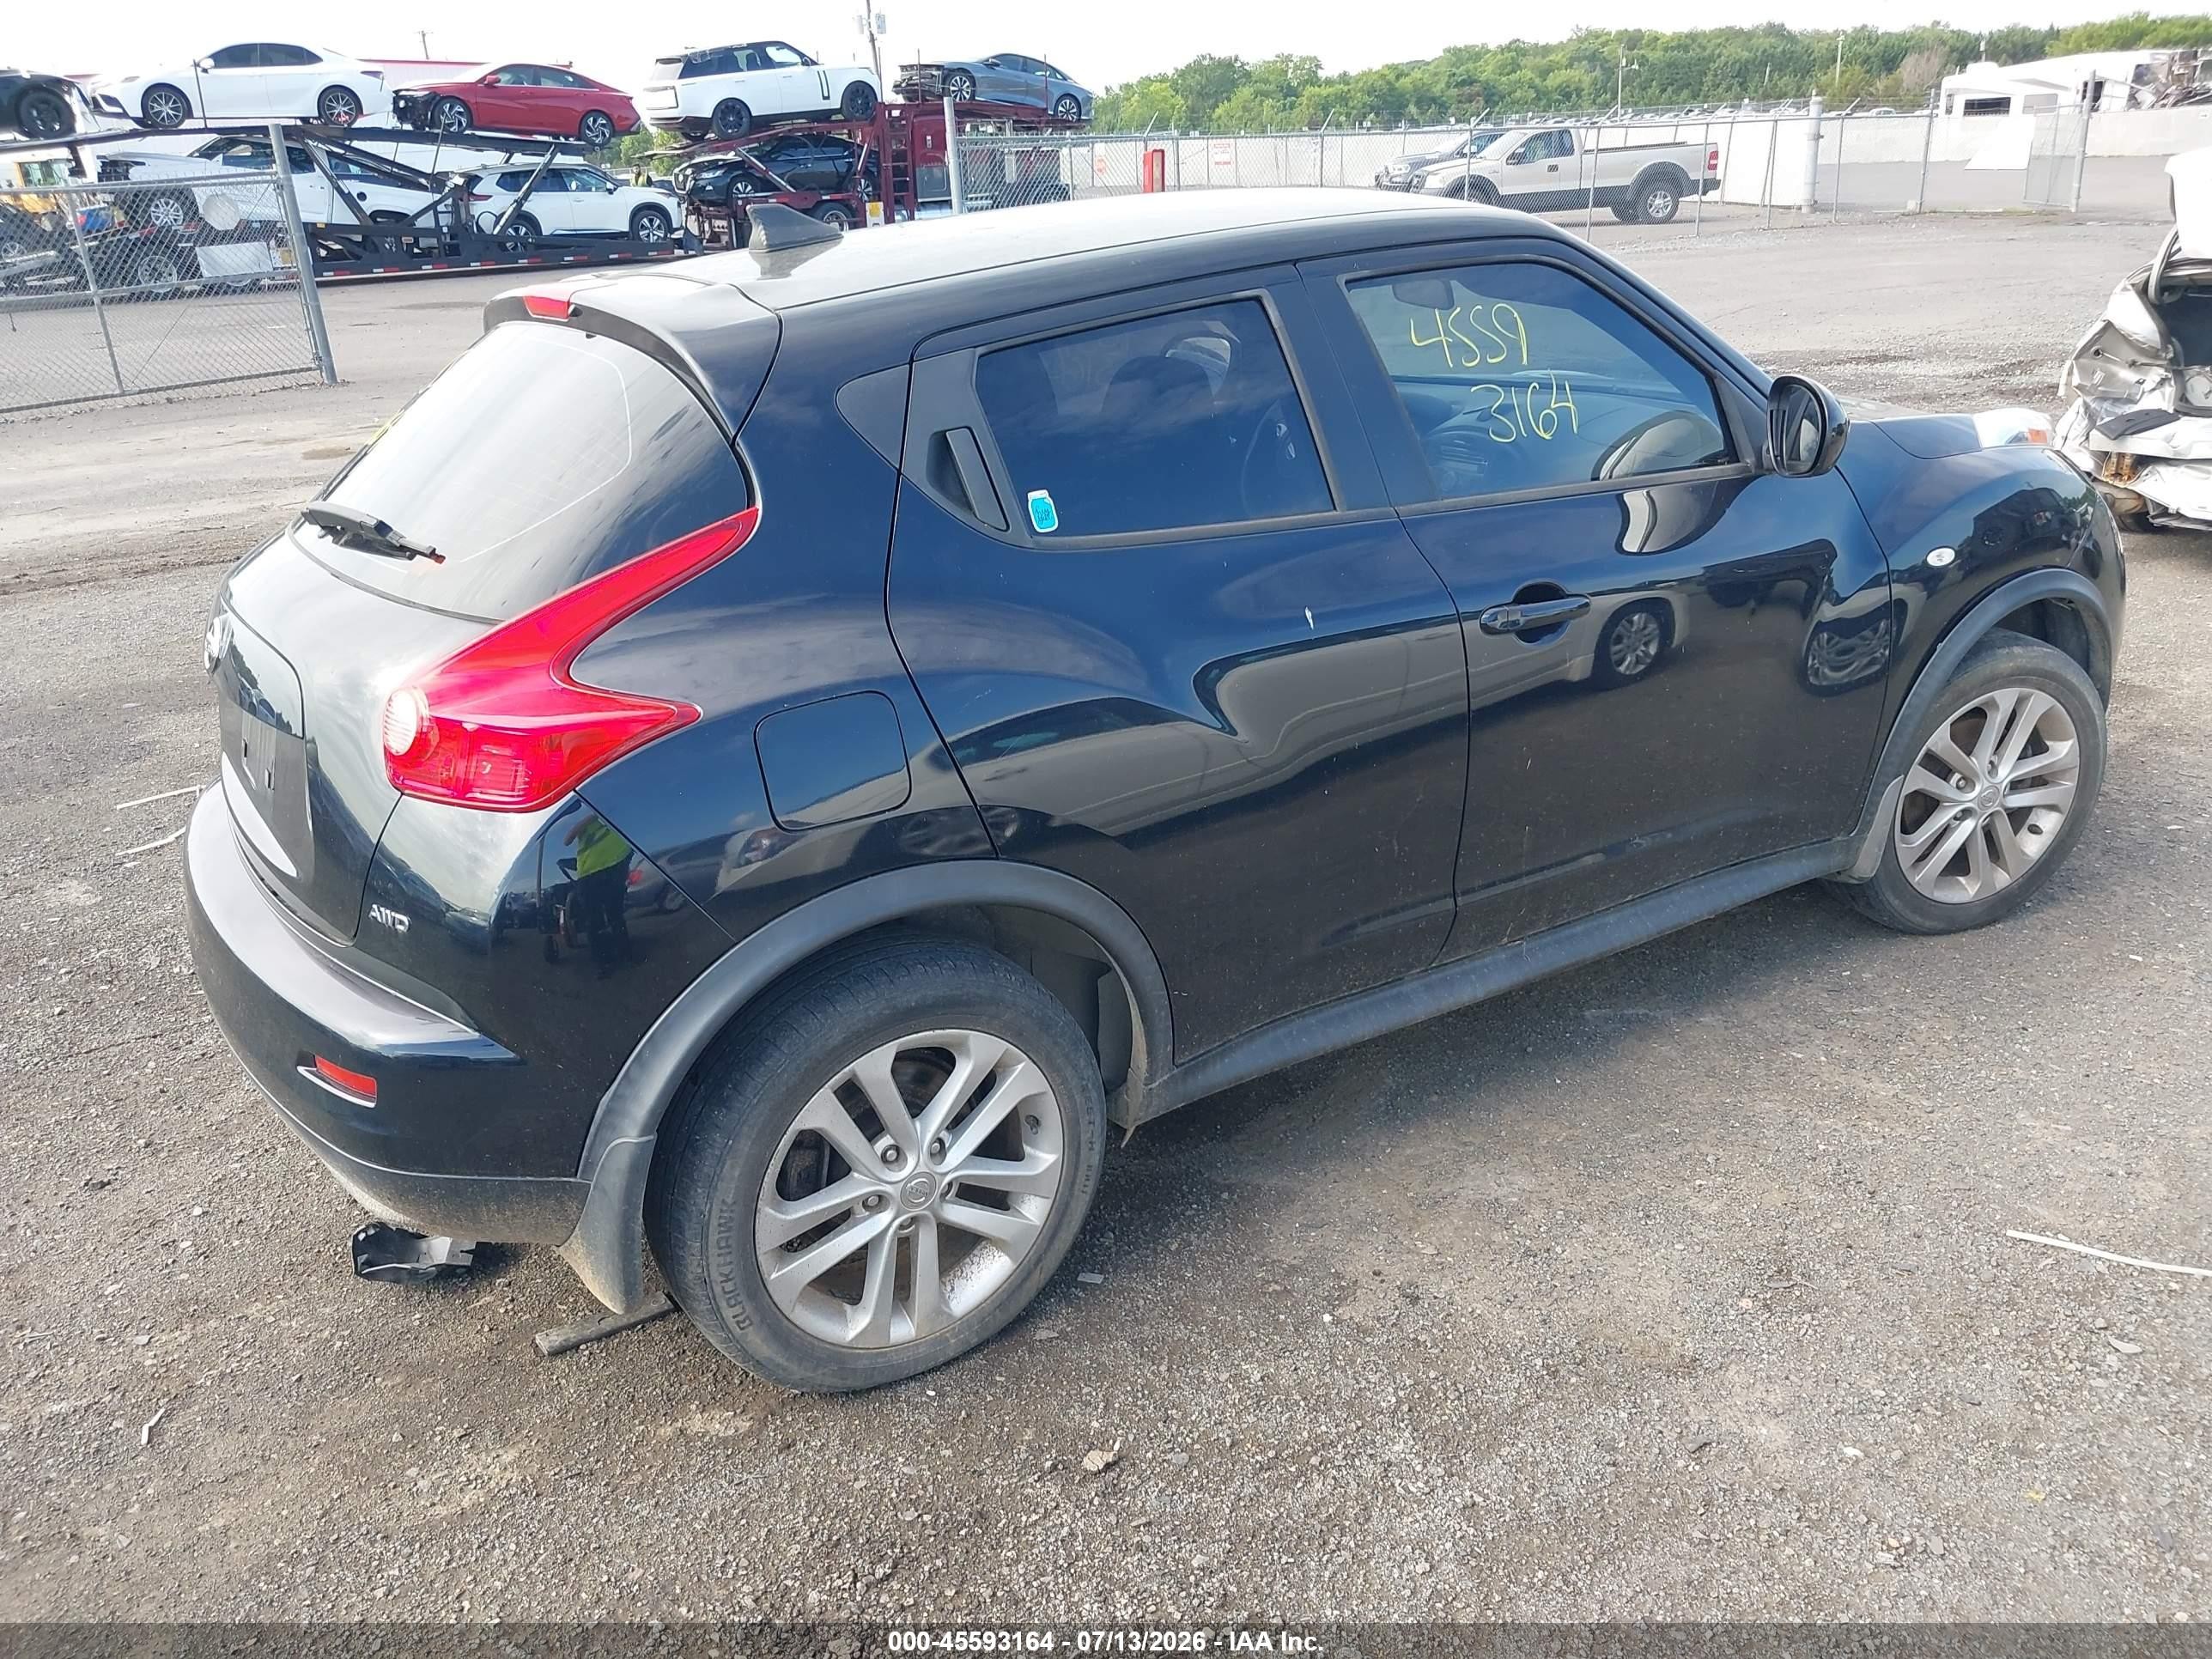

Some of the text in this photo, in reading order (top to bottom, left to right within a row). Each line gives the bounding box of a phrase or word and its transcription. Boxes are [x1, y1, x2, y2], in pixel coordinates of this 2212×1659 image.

[1411, 303, 1528, 368] 4559
[1471, 368, 1578, 442] 3164
[368, 904, 410, 933] AWD
[716, 1198, 753, 1331] BLACKHAWK
